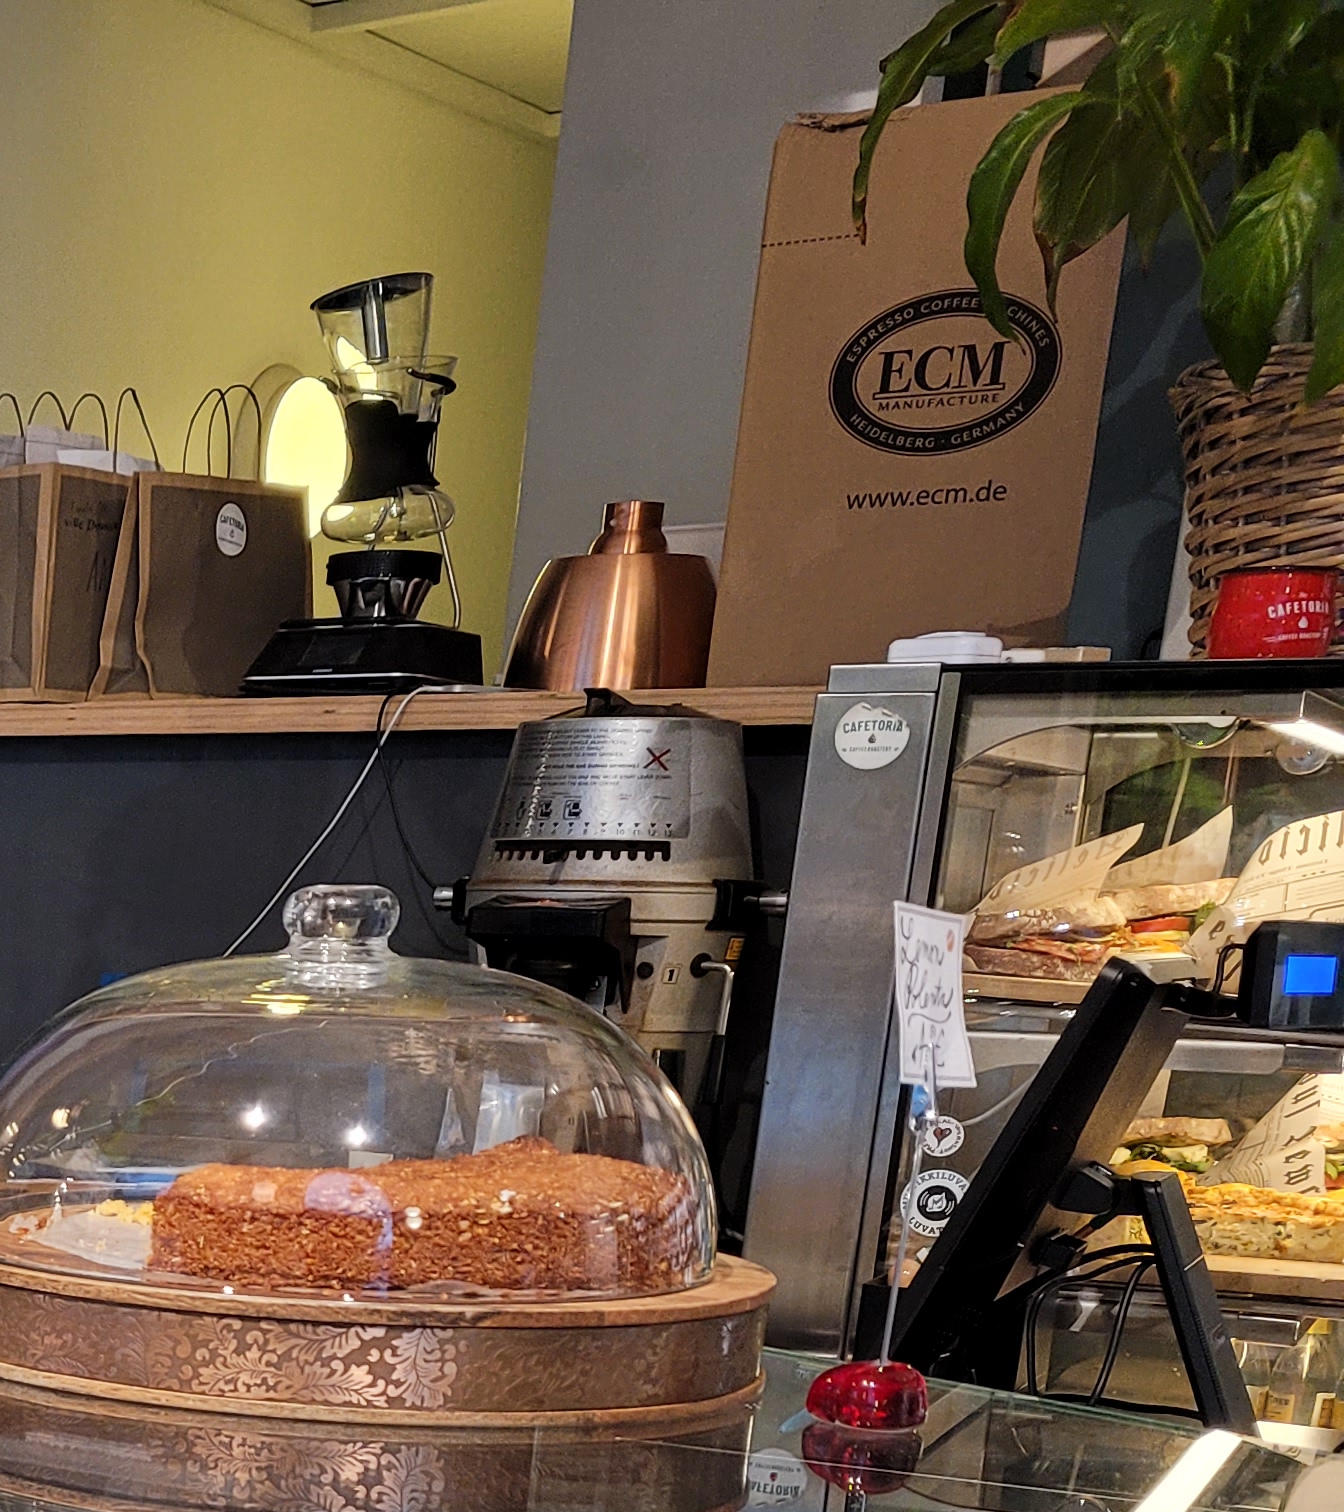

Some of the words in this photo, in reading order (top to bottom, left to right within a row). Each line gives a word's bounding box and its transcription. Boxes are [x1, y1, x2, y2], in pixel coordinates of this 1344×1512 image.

[846, 308, 914, 363] ESPRESSO
[920, 297, 979, 313] COFFEE
[1007, 305, 1050, 347] CHINES
[878, 341, 1011, 395] ECM
[877, 393, 1000, 412] MANUFACTURE
[849, 414, 935, 448] HEIDELBERG
[950, 402, 1025, 445] GERMANY
[846, 479, 1007, 510] www.ecm.de
[843, 719, 904, 734] CAFETORIA
